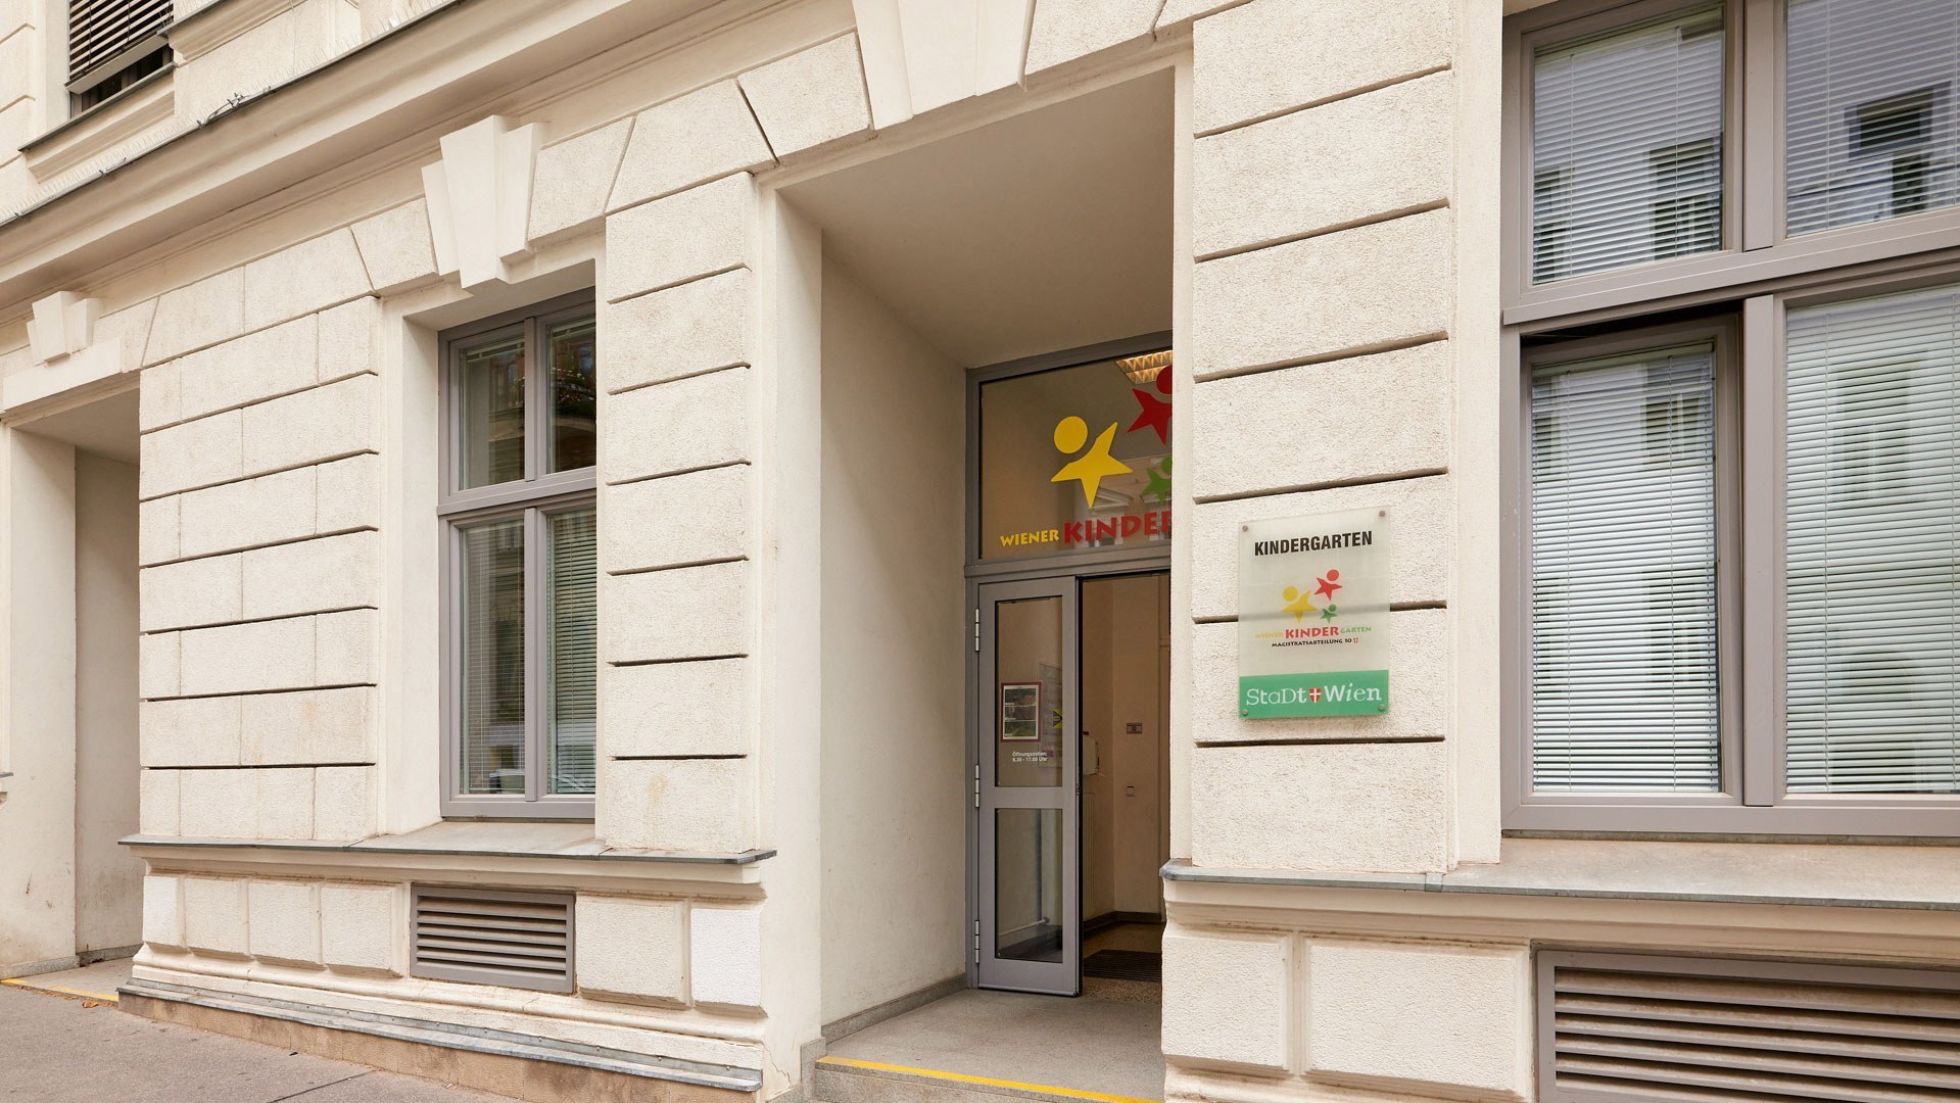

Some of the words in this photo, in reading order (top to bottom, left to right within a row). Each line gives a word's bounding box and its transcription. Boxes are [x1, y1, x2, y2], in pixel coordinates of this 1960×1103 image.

[1000, 529, 1060, 547] WIENER
[1254, 530, 1373, 556] KINDERGARTEN
[1285, 626, 1339, 639] KINDER
[1340, 626, 1372, 634] GARTEN
[1271, 638, 1343, 648] MAGISTRATSABTEILUNG
[1324, 683, 1382, 702] Wien
